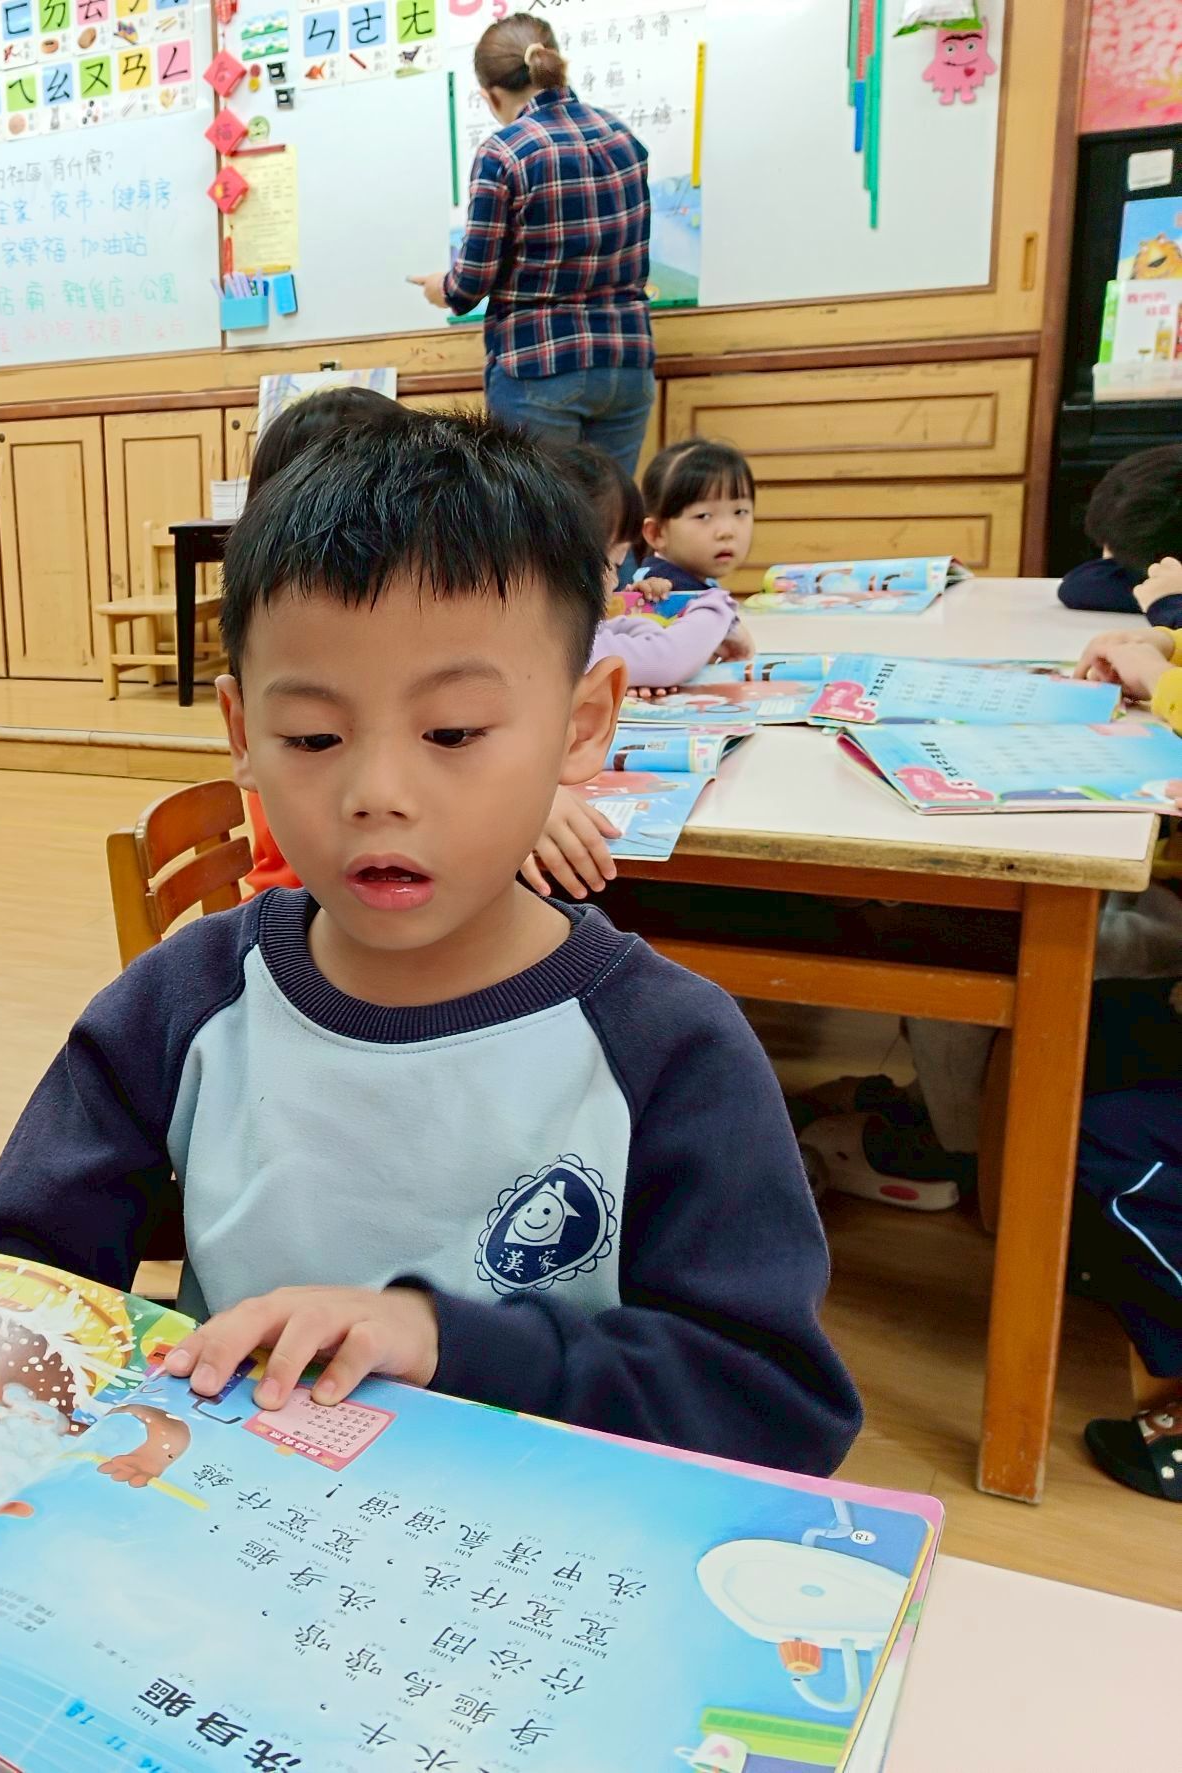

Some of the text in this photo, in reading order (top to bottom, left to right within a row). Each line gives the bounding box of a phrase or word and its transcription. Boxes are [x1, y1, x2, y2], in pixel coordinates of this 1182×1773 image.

[6, 2, 30, 35] ㄈ
[352, 8, 382, 43] ㄜ
[400, 2, 433, 38] ㄤ
[8, 79, 34, 104] ㄟ
[47, 69, 70, 102] ㄠ
[84, 62, 109, 94] ㄡ
[122, 53, 147, 85] ㄢ
[162, 47, 188, 80] ㄥ
[50, 189, 92, 222] 夜市
[0, 236, 67, 268] 家樂福
[80, 232, 148, 259] 加油站
[496, 1247, 559, 1278] 漢家
[324, 1483, 647, 1596] 洗甲清氣溜溜！
[855, 1532, 869, 1541] 18
[208, 1524, 585, 1694] 佇浴間，洗身軀；
[260, 1611, 555, 1745] 身軀烏嚕嚕，
[127, 1703, 161, 1728] khu
[136, 1677, 302, 1767] 洗身軀
